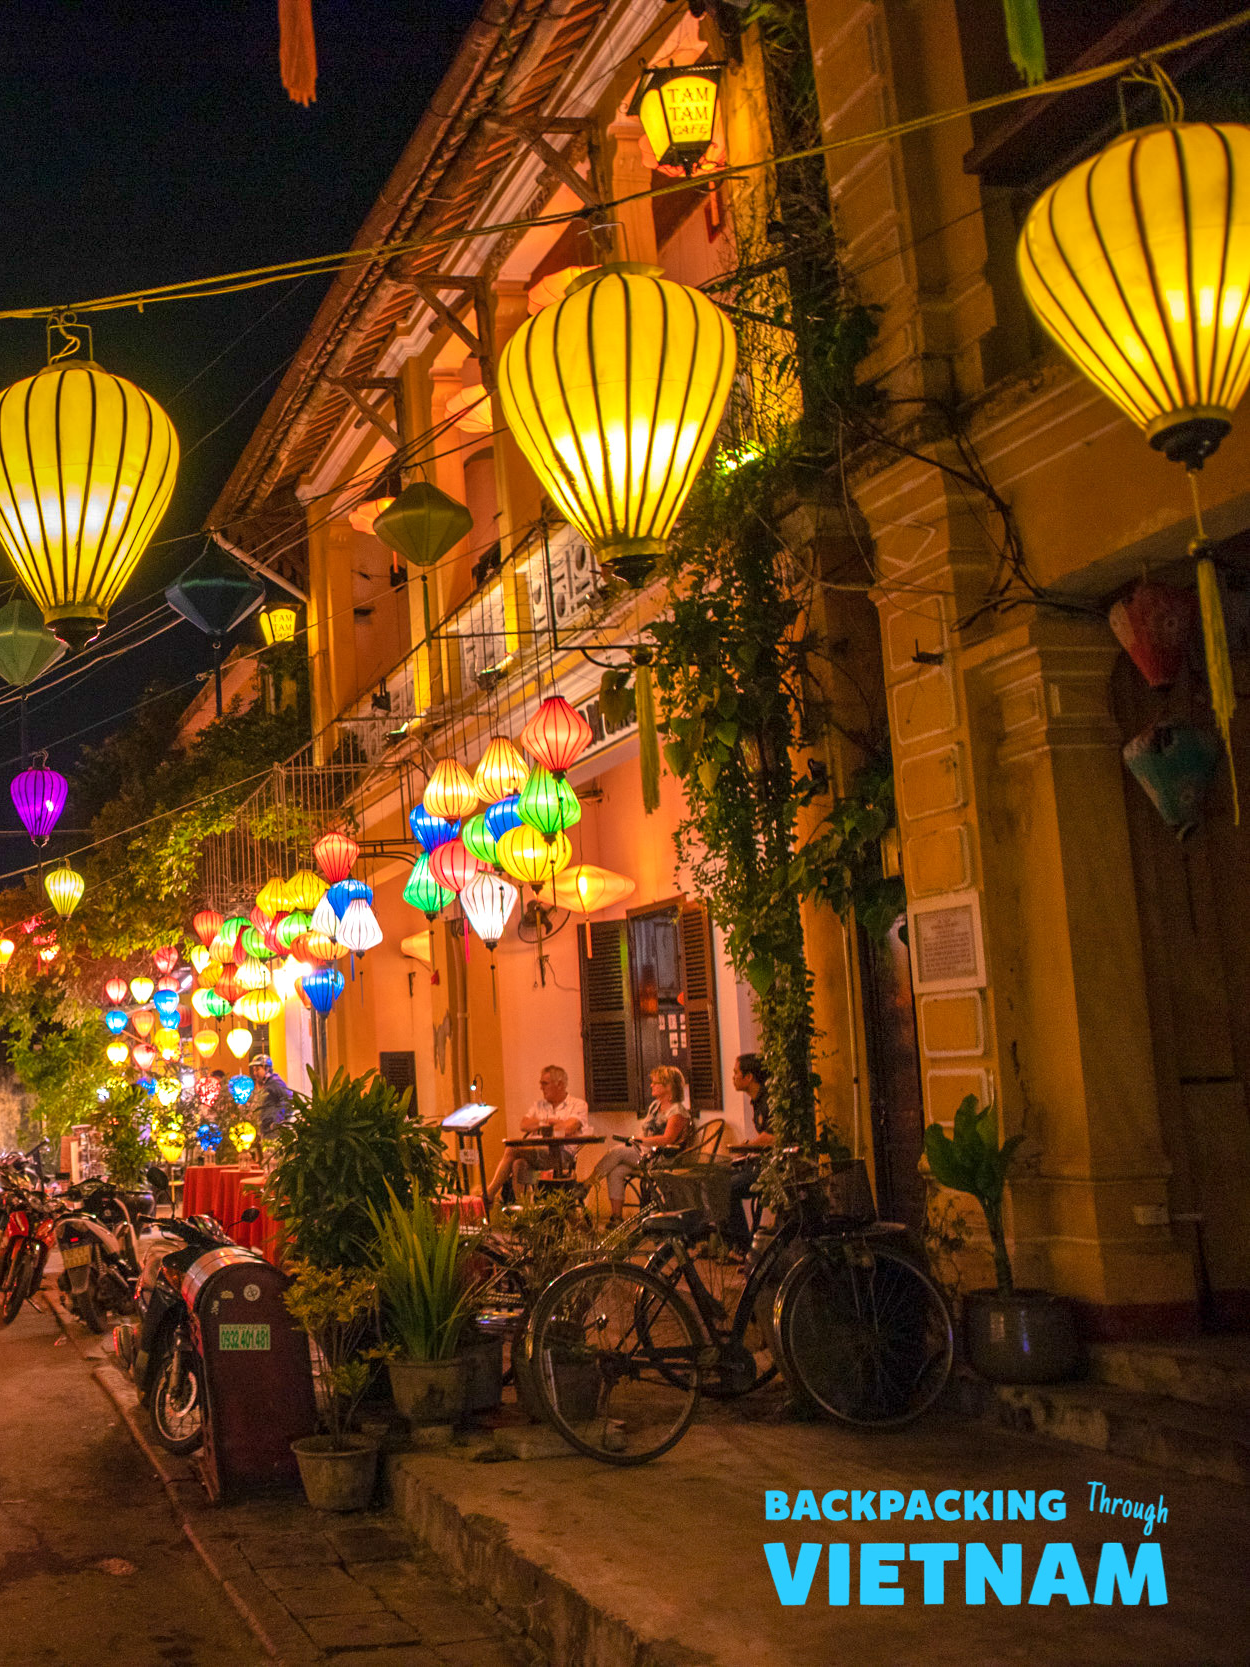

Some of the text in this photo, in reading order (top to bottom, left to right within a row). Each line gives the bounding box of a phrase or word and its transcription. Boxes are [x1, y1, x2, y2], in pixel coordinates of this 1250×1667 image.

[667, 87, 709, 103] TAM
[669, 106, 709, 121] TAM
[272, 614, 292, 622] TAM
[273, 623, 292, 631] TAM
